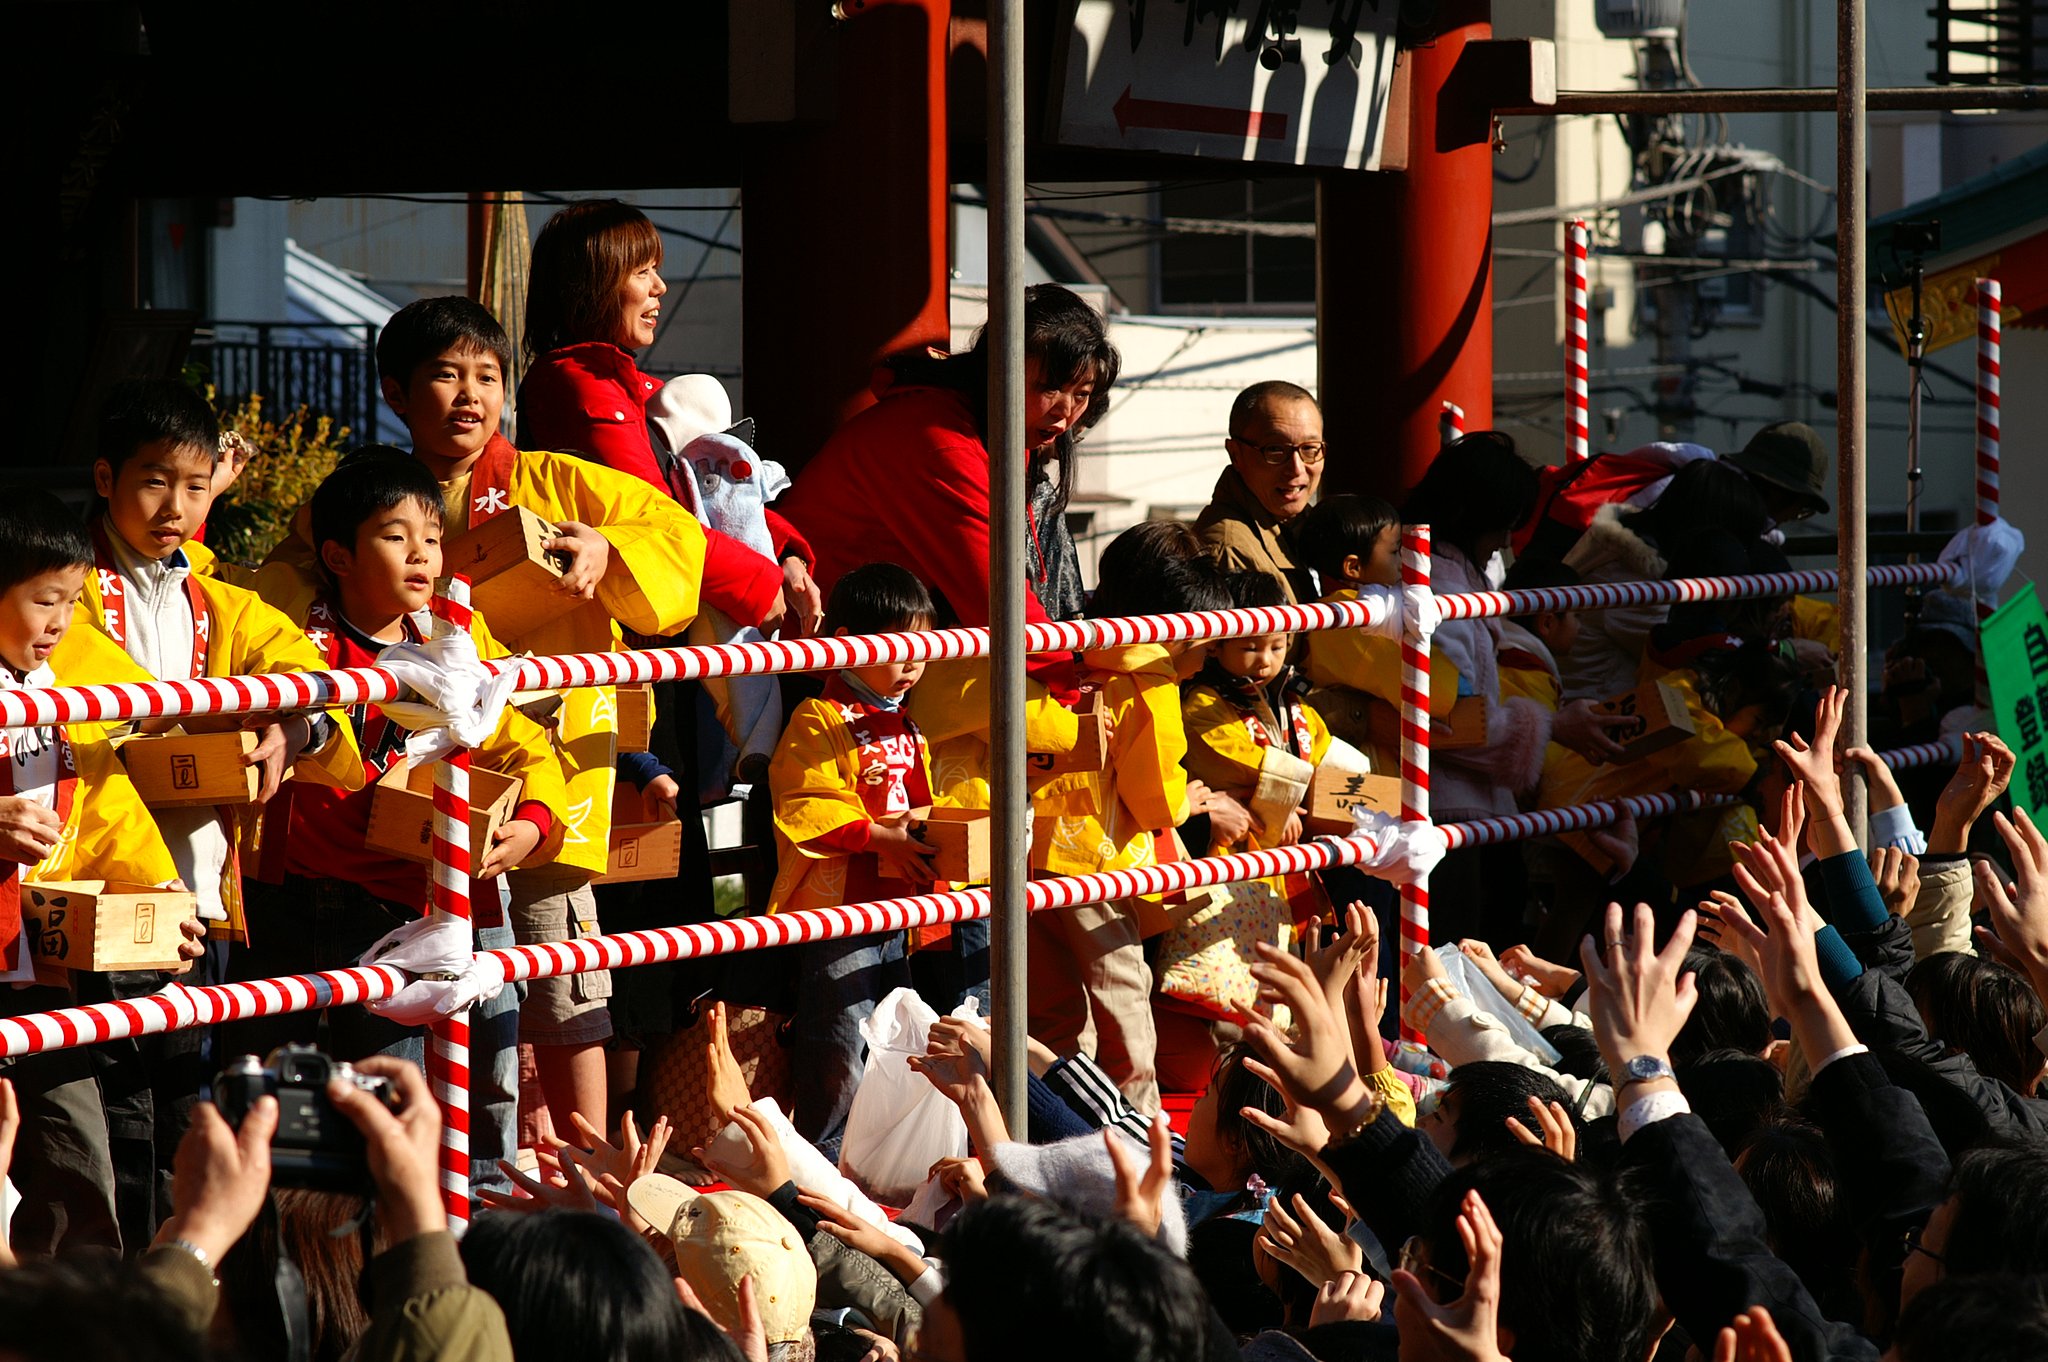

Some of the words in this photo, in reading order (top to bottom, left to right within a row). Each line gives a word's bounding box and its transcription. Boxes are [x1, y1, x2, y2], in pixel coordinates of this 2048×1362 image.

[474, 487, 510, 514] 水
[307, 602, 337, 652] 水天
[840, 702, 888, 786] 水天宮
